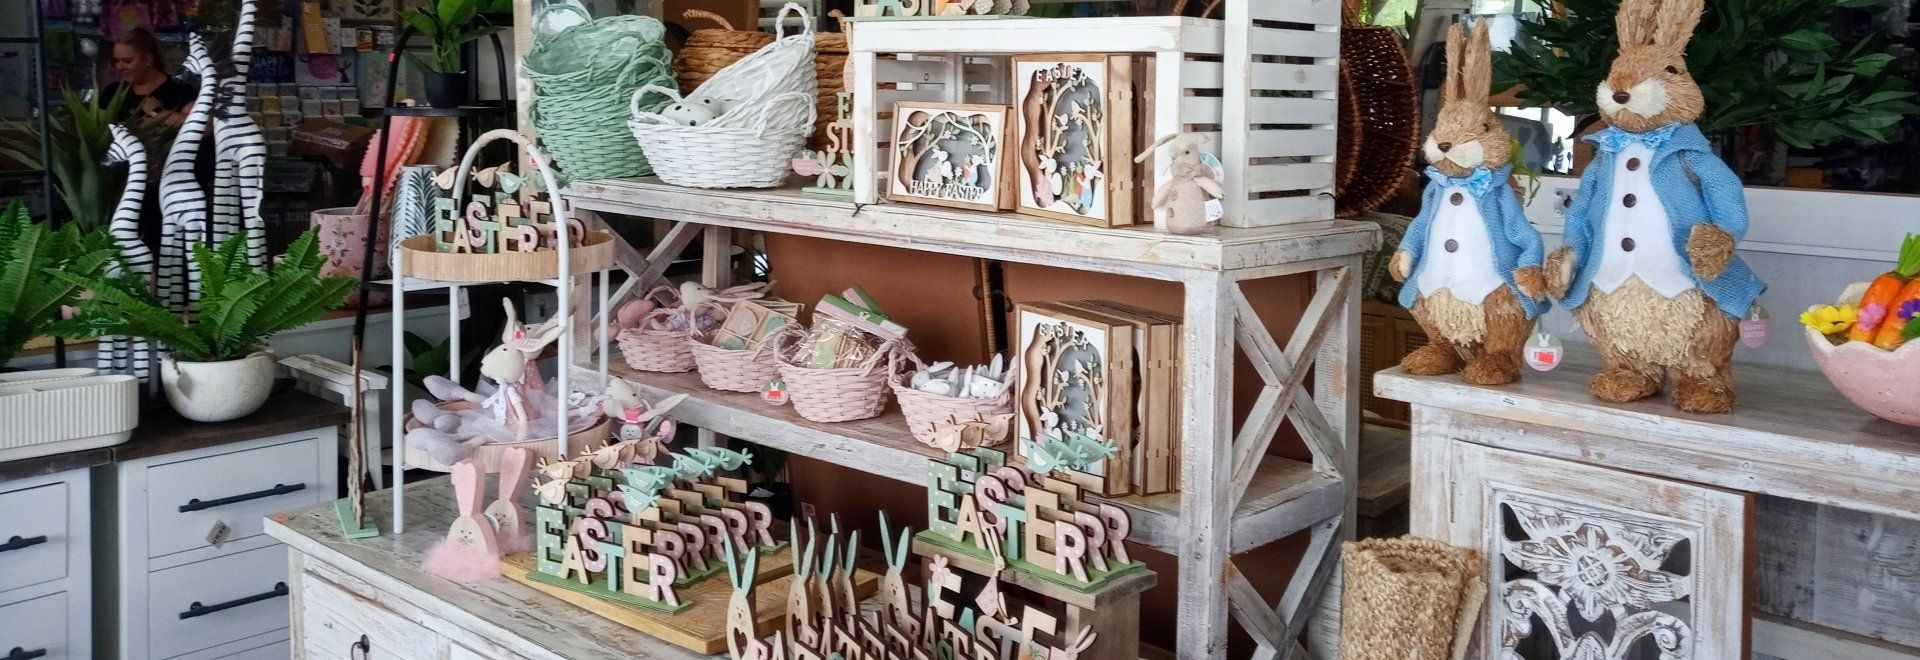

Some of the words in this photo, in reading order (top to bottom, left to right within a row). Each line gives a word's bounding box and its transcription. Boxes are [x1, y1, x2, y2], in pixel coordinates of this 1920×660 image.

[1036, 63, 1087, 87] EASTER
[909, 180, 944, 197] HAPPY
[945, 184, 984, 200] EASTER
[434, 196, 540, 254] EASTER
[1039, 321, 1089, 351] EASTER
[926, 458, 1090, 584] EASTER
[535, 505, 682, 608] EASTER
